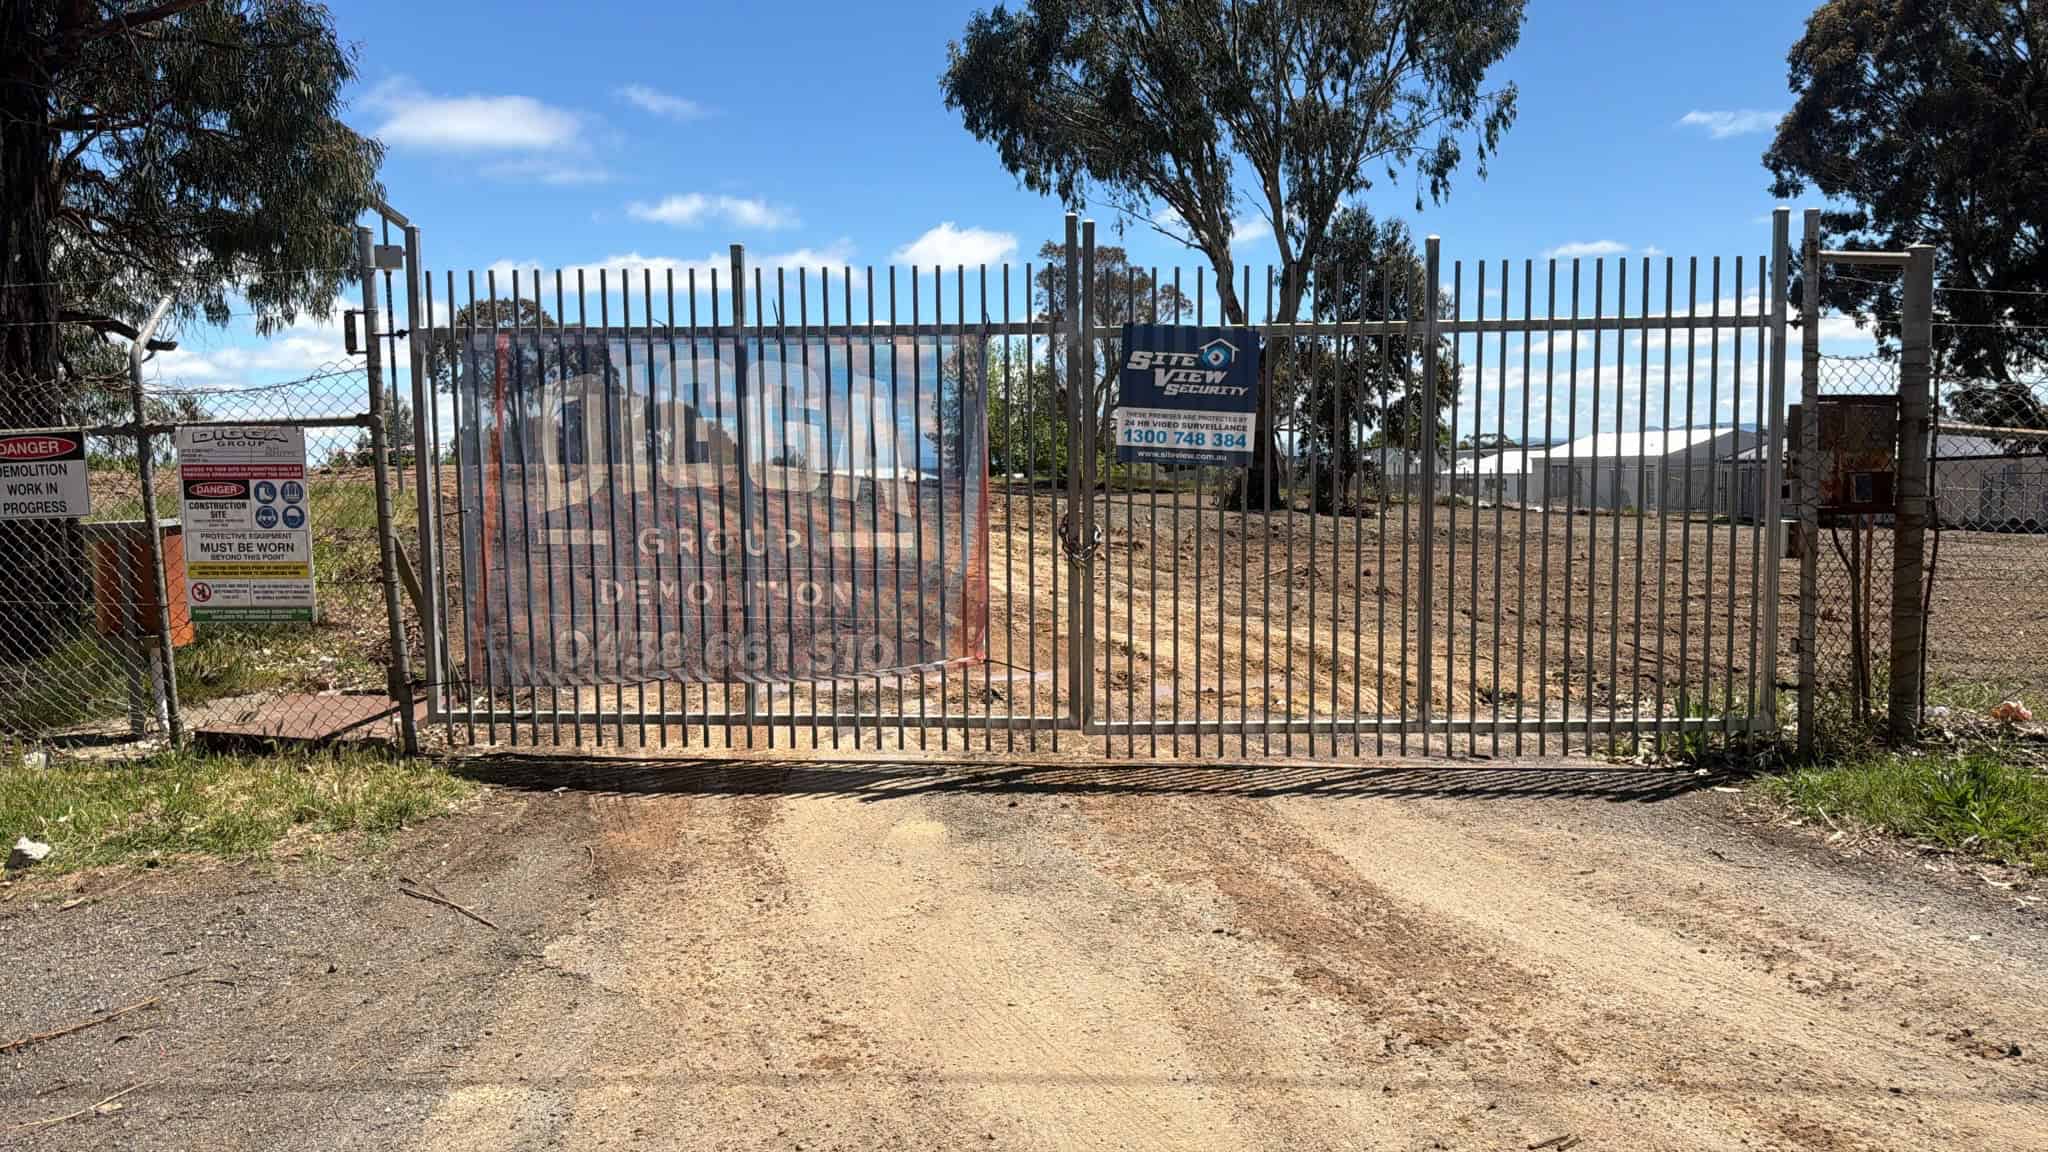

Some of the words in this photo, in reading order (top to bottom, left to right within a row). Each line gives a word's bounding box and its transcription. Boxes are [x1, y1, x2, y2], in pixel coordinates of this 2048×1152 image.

[1127, 351, 1199, 370] SITE
[1154, 368, 1228, 387] VIEW
[1163, 384, 1248, 396] SECURITY
[1125, 419, 1136, 427] 24
[1152, 421, 1180, 429] VIDEO
[1182, 422, 1248, 432] SURVEILLANCE
[1124, 428, 1168, 443] 1300
[1173, 431, 1206, 446] 748
[1212, 432, 1248, 449] 384
[0, 463, 68, 478] EMOLITION
[7, 482, 43, 496] WORK
[46, 481, 58, 495] IN
[196, 483, 238, 495] DANGER
[3, 500, 68, 514] PROGRESS
[189, 501, 247, 510] CONSTRUCTION
[210, 510, 227, 519] SITE
[200, 532, 247, 540] PROTECTIVE
[248, 532, 292, 540] EQUIPMENT
[637, 527, 803, 557] GROUP
[200, 542, 235, 553] MUST
[238, 542, 254, 553] BE
[256, 542, 295, 553] WORN
[210, 553, 242, 561] BEYOND
